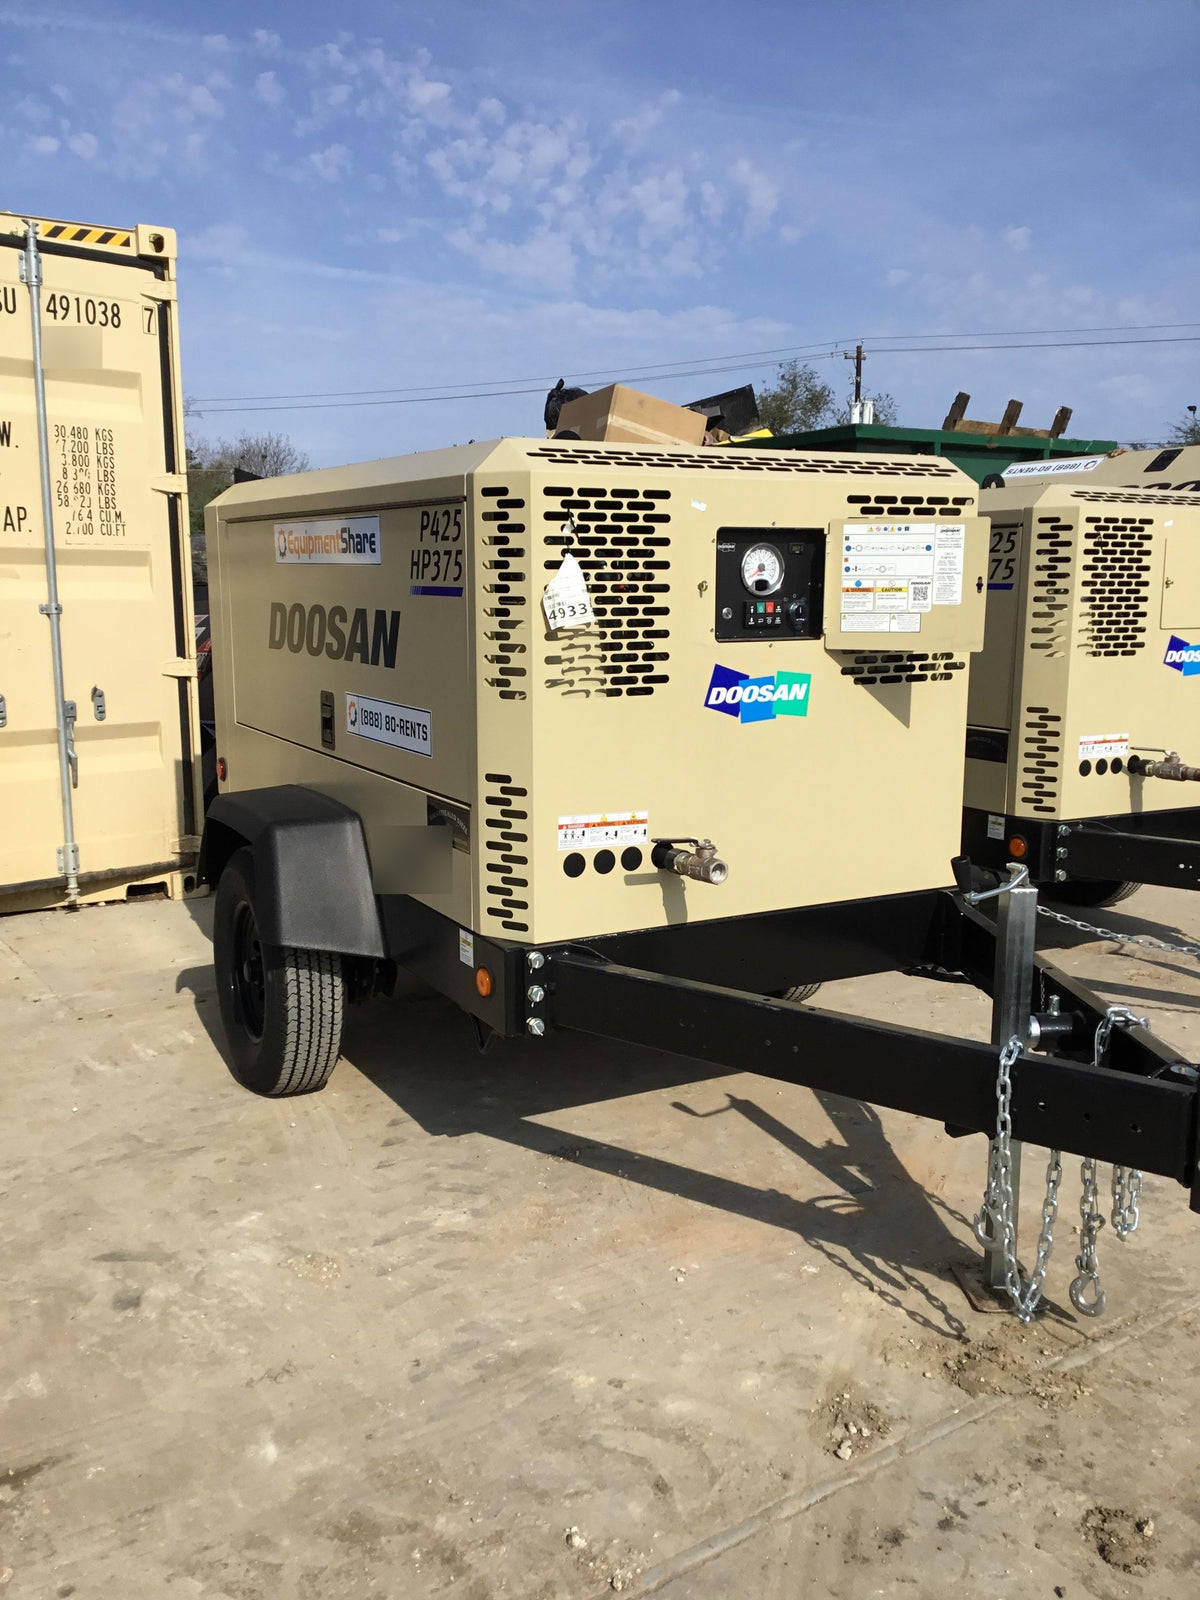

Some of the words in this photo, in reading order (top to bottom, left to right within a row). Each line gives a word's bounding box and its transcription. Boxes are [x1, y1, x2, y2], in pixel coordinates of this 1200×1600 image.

[46, 293, 122, 329] 491038
[143, 307, 154, 333] 7
[54, 424, 88, 440] 30.480
[95, 428, 114, 442] KGS
[96, 442, 115, 456] LBS
[97, 456, 115, 470] KGS
[97, 469, 116, 483] LBS
[98, 483, 116, 496] KGS
[99, 496, 117, 510] LBS
[99, 510, 126, 523] CU.M.
[100, 523, 126, 537] CU.FT
[420, 509, 462, 543] P425
[287, 527, 376, 560] EquipmentShare
[410, 549, 463, 582] HP375
[548, 603, 588, 621] 4933
[268, 602, 401, 669] DOOSAN
[707, 683, 808, 705] DOOSAN
[361, 707, 382, 731] (888)
[385, 715, 428, 742] 80-RENTS
